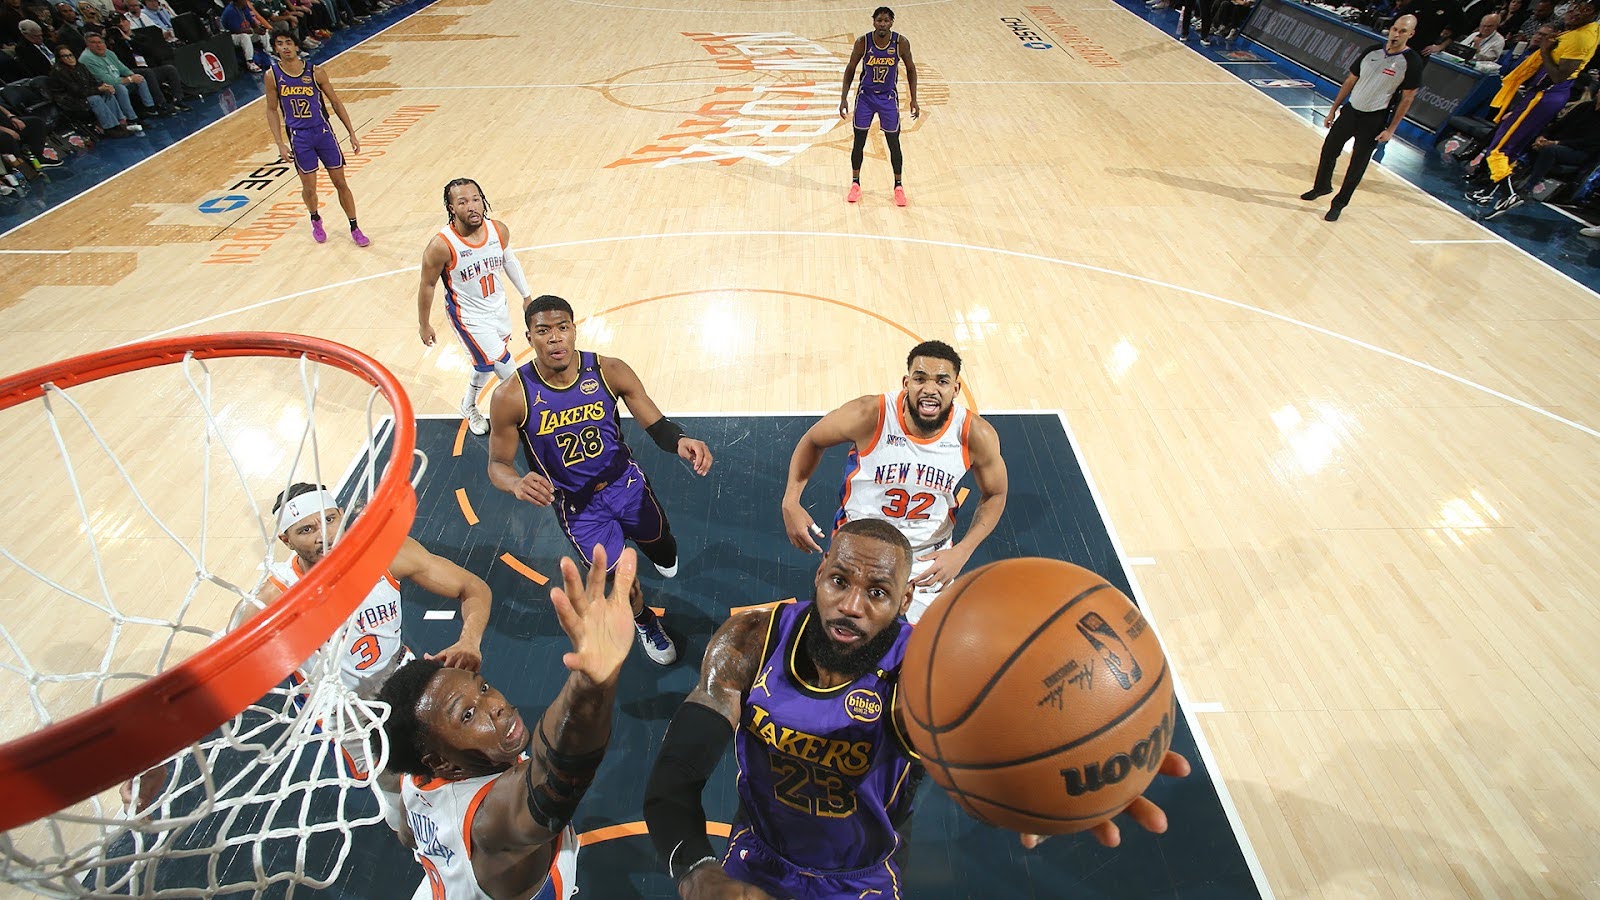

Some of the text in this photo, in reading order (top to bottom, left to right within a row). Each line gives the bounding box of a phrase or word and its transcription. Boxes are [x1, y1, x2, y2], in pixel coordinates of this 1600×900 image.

[1000, 17, 1044, 42] CHASE
[1251, 5, 1273, 28] THE
[1262, 9, 1297, 42] BETTER
[1286, 20, 1313, 50] WAY
[1304, 28, 1325, 55] TO
[1318, 35, 1343, 63] NBA
[866, 55, 895, 66] LAKERS
[873, 66, 889, 83] 17
[280, 84, 314, 97] LAKERS
[1414, 85, 1459, 113] Microsoft
[290, 98, 312, 118] 12
[603, 80, 856, 168] YORK
[360, 104, 442, 147] MADISON
[201, 201, 327, 264] GARDEN
[460, 261, 482, 282] NEW
[479, 273, 496, 298] 11
[536, 400, 606, 436] LAKERS
[555, 425, 604, 468] 28
[874, 462, 955, 493] NEW YORK
[881, 488, 936, 520] 32
[356, 600, 398, 634] YORK
[350, 633, 382, 671] 3
[848, 695, 880, 714] bibigo
[746, 704, 874, 777] LAKERS
[1060, 708, 1173, 797] ilson
[770, 752, 858, 818] 23
